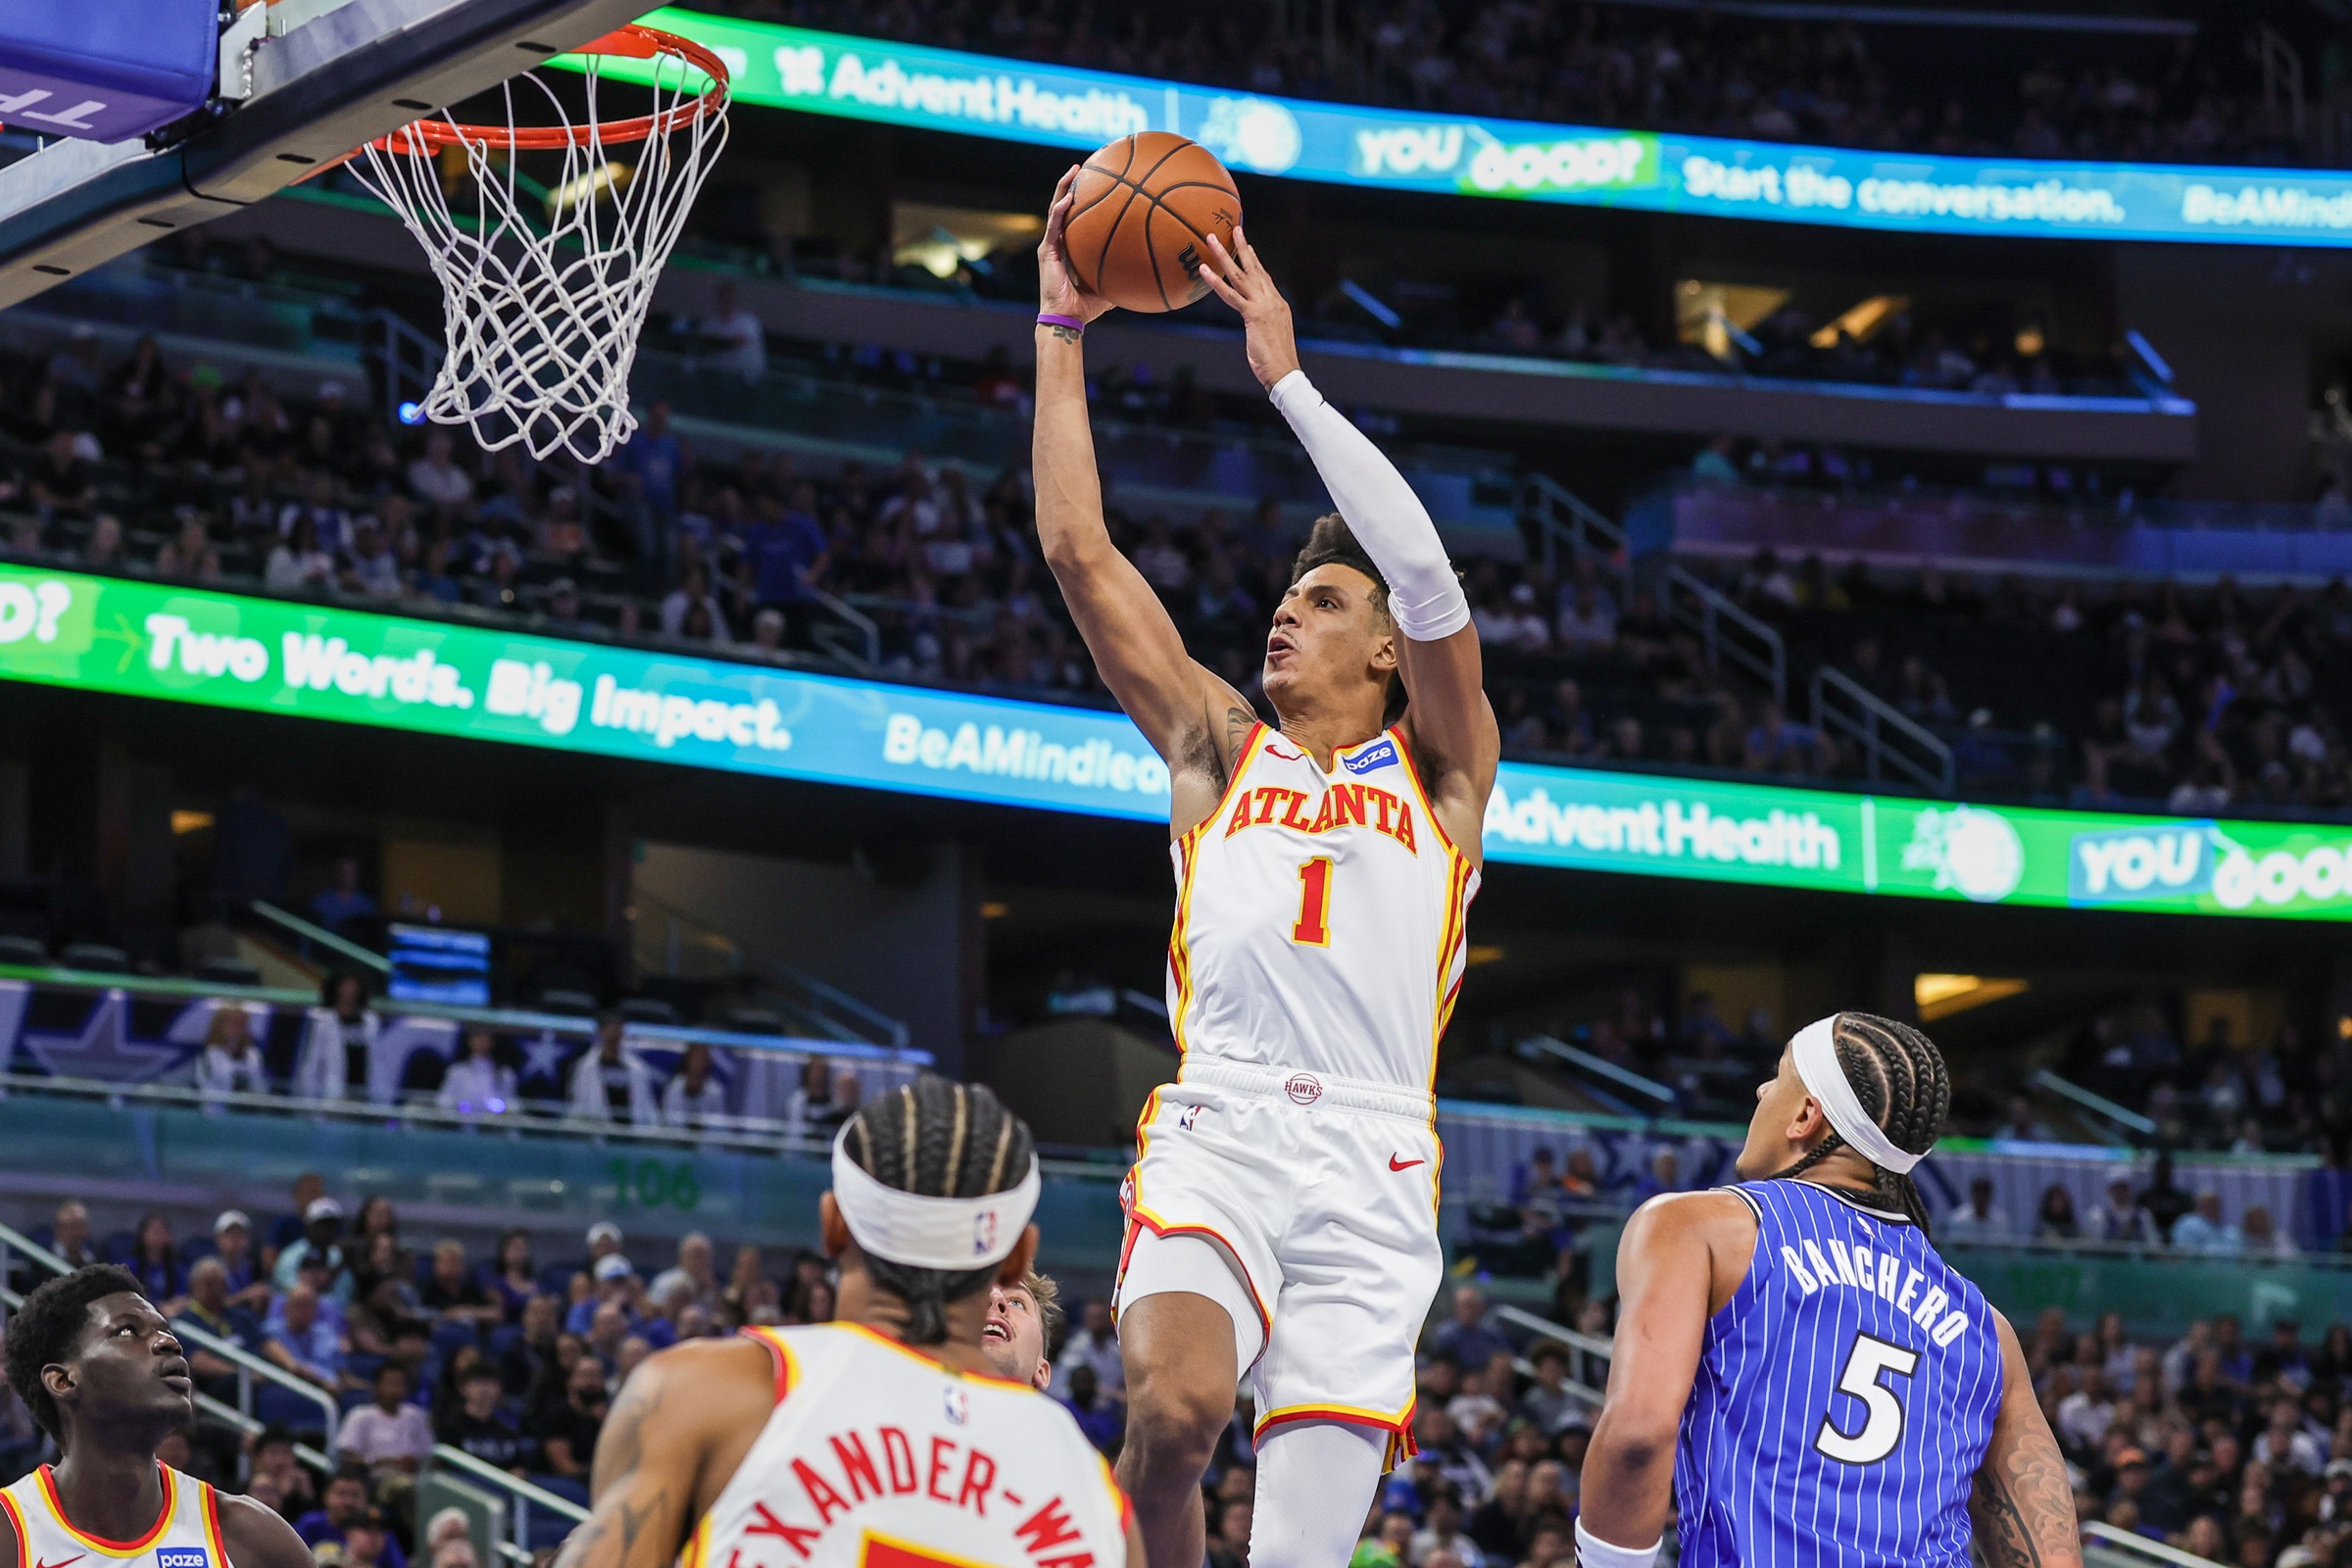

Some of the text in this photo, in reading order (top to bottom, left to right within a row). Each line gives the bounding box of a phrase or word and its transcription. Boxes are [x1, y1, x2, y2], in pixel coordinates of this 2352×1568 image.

[829, 53, 1149, 137] AdventHealth
[1356, 125, 1465, 174] YOU
[1682, 155, 2126, 224] Start the conversation.
[145, 612, 792, 751] Two Words. Big Impact.
[1224, 782, 1418, 858] ATLANTA
[1483, 785, 1840, 870] AdventHealth
[1291, 856, 1334, 949] 1
[2078, 833, 2352, 909] YOU GOO
[1284, 1081, 1323, 1097] HAWKS
[606, 1156, 701, 1213] 106
[1780, 1238, 1970, 1348] BANCHERO
[1813, 1329, 1923, 1467] 5
[160, 1554, 205, 1568] paze
